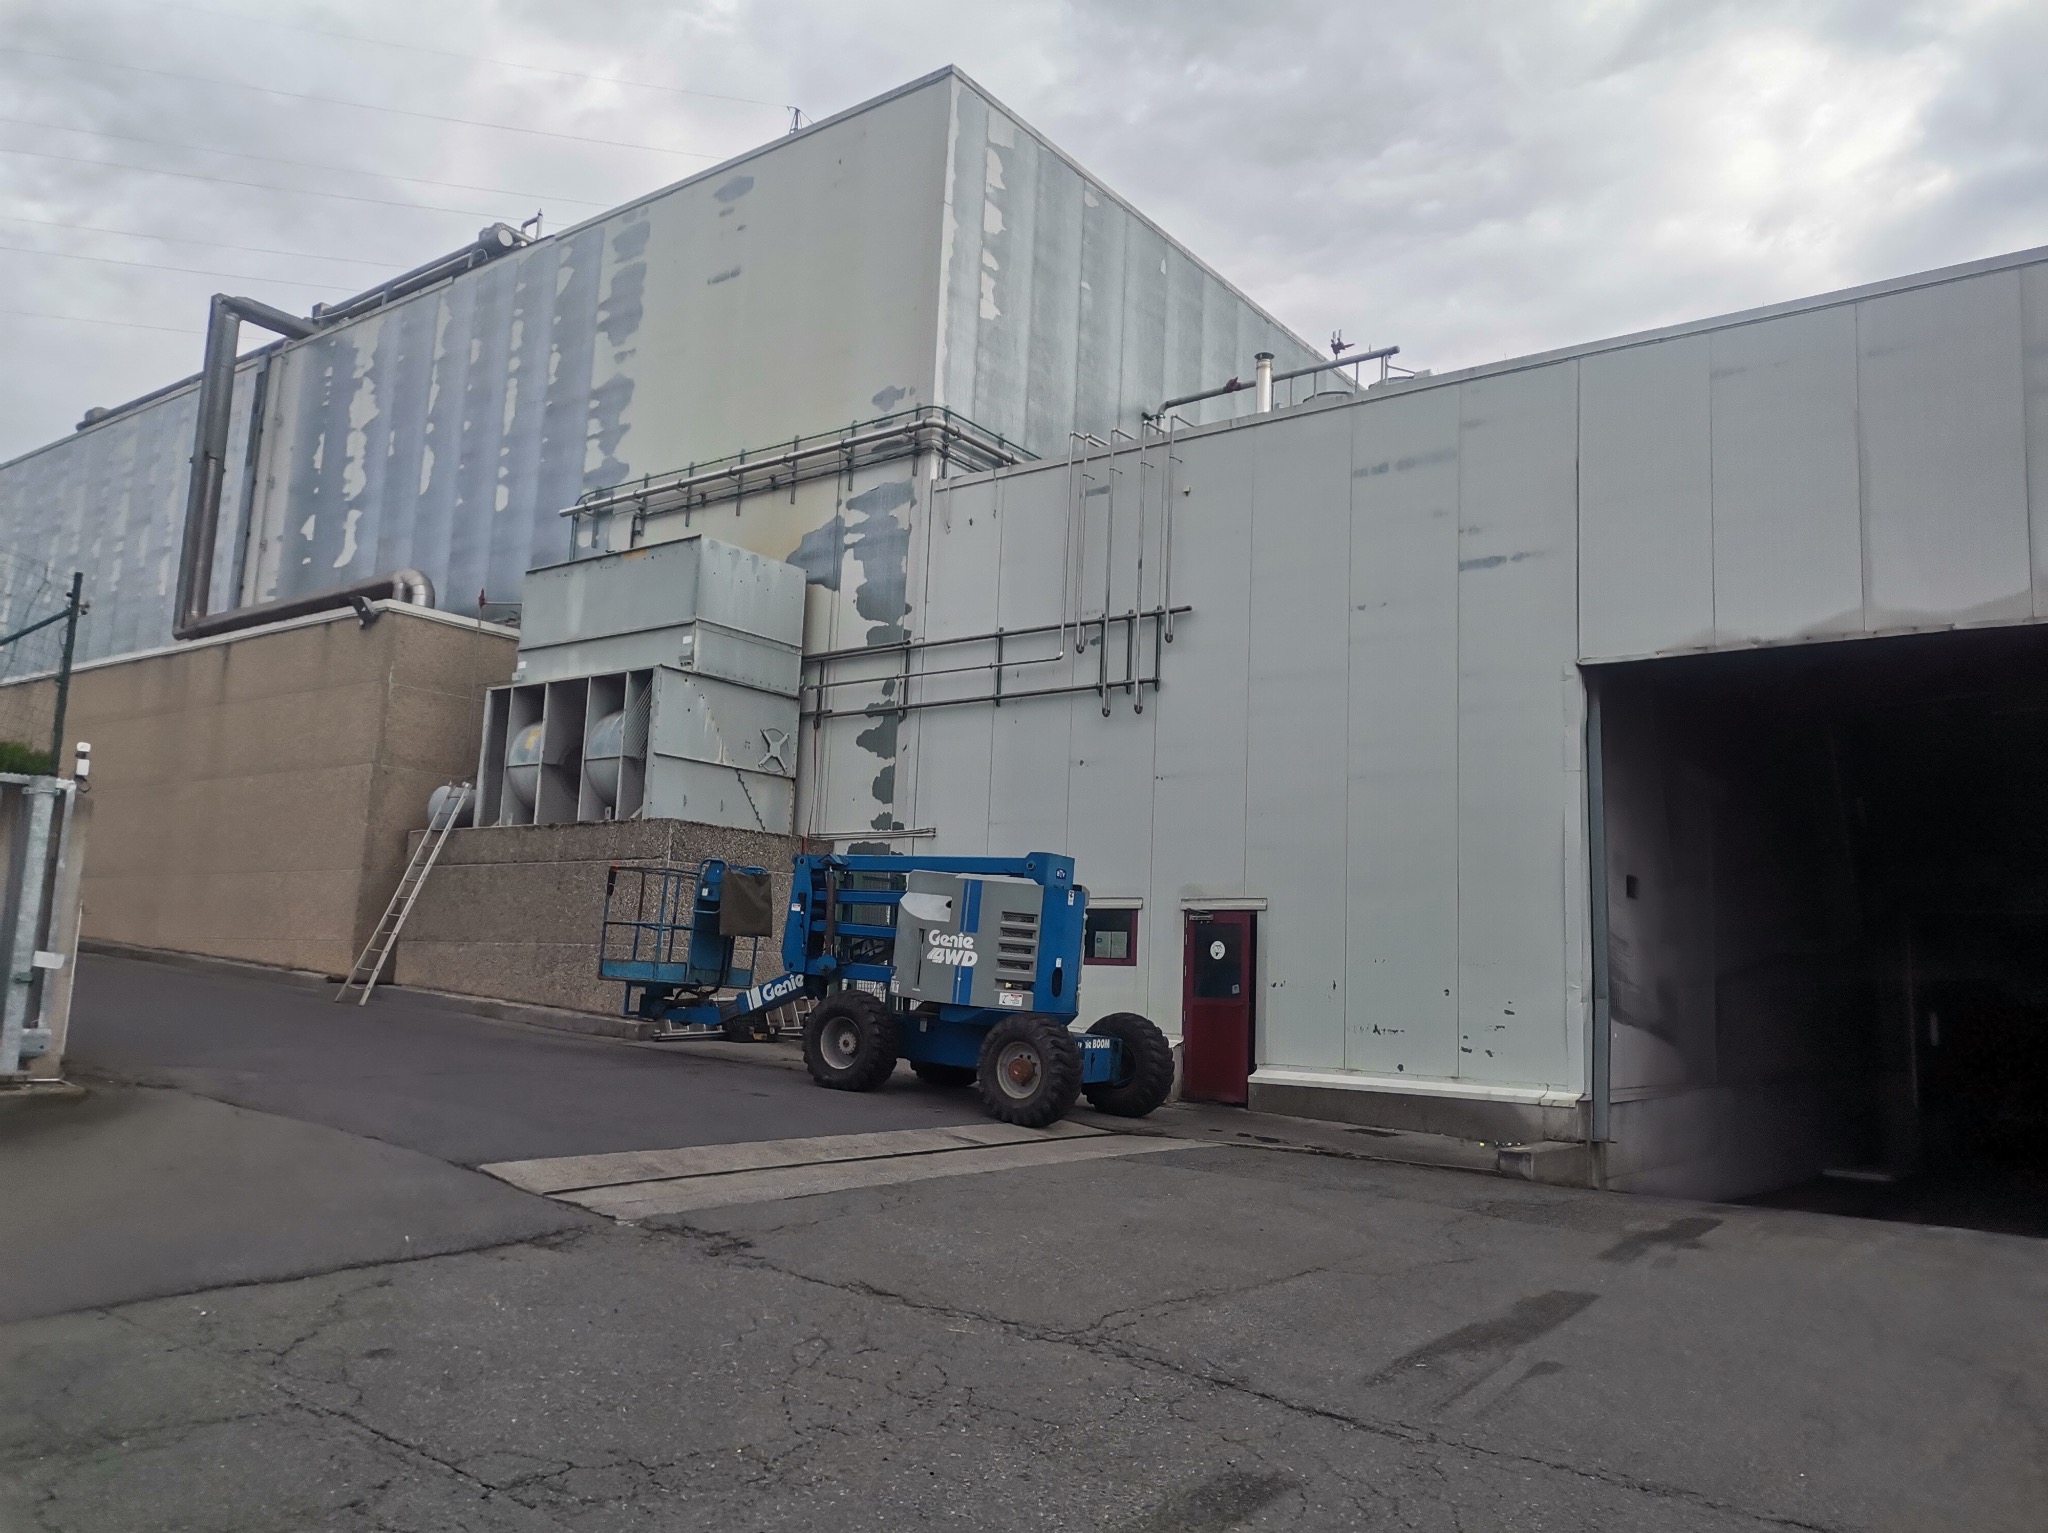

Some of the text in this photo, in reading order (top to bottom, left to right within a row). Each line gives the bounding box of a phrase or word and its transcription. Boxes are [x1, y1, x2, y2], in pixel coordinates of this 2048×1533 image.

[928, 929, 974, 949] Genie
[926, 947, 978, 967] 4WD
[762, 973, 805, 1001] Genie
